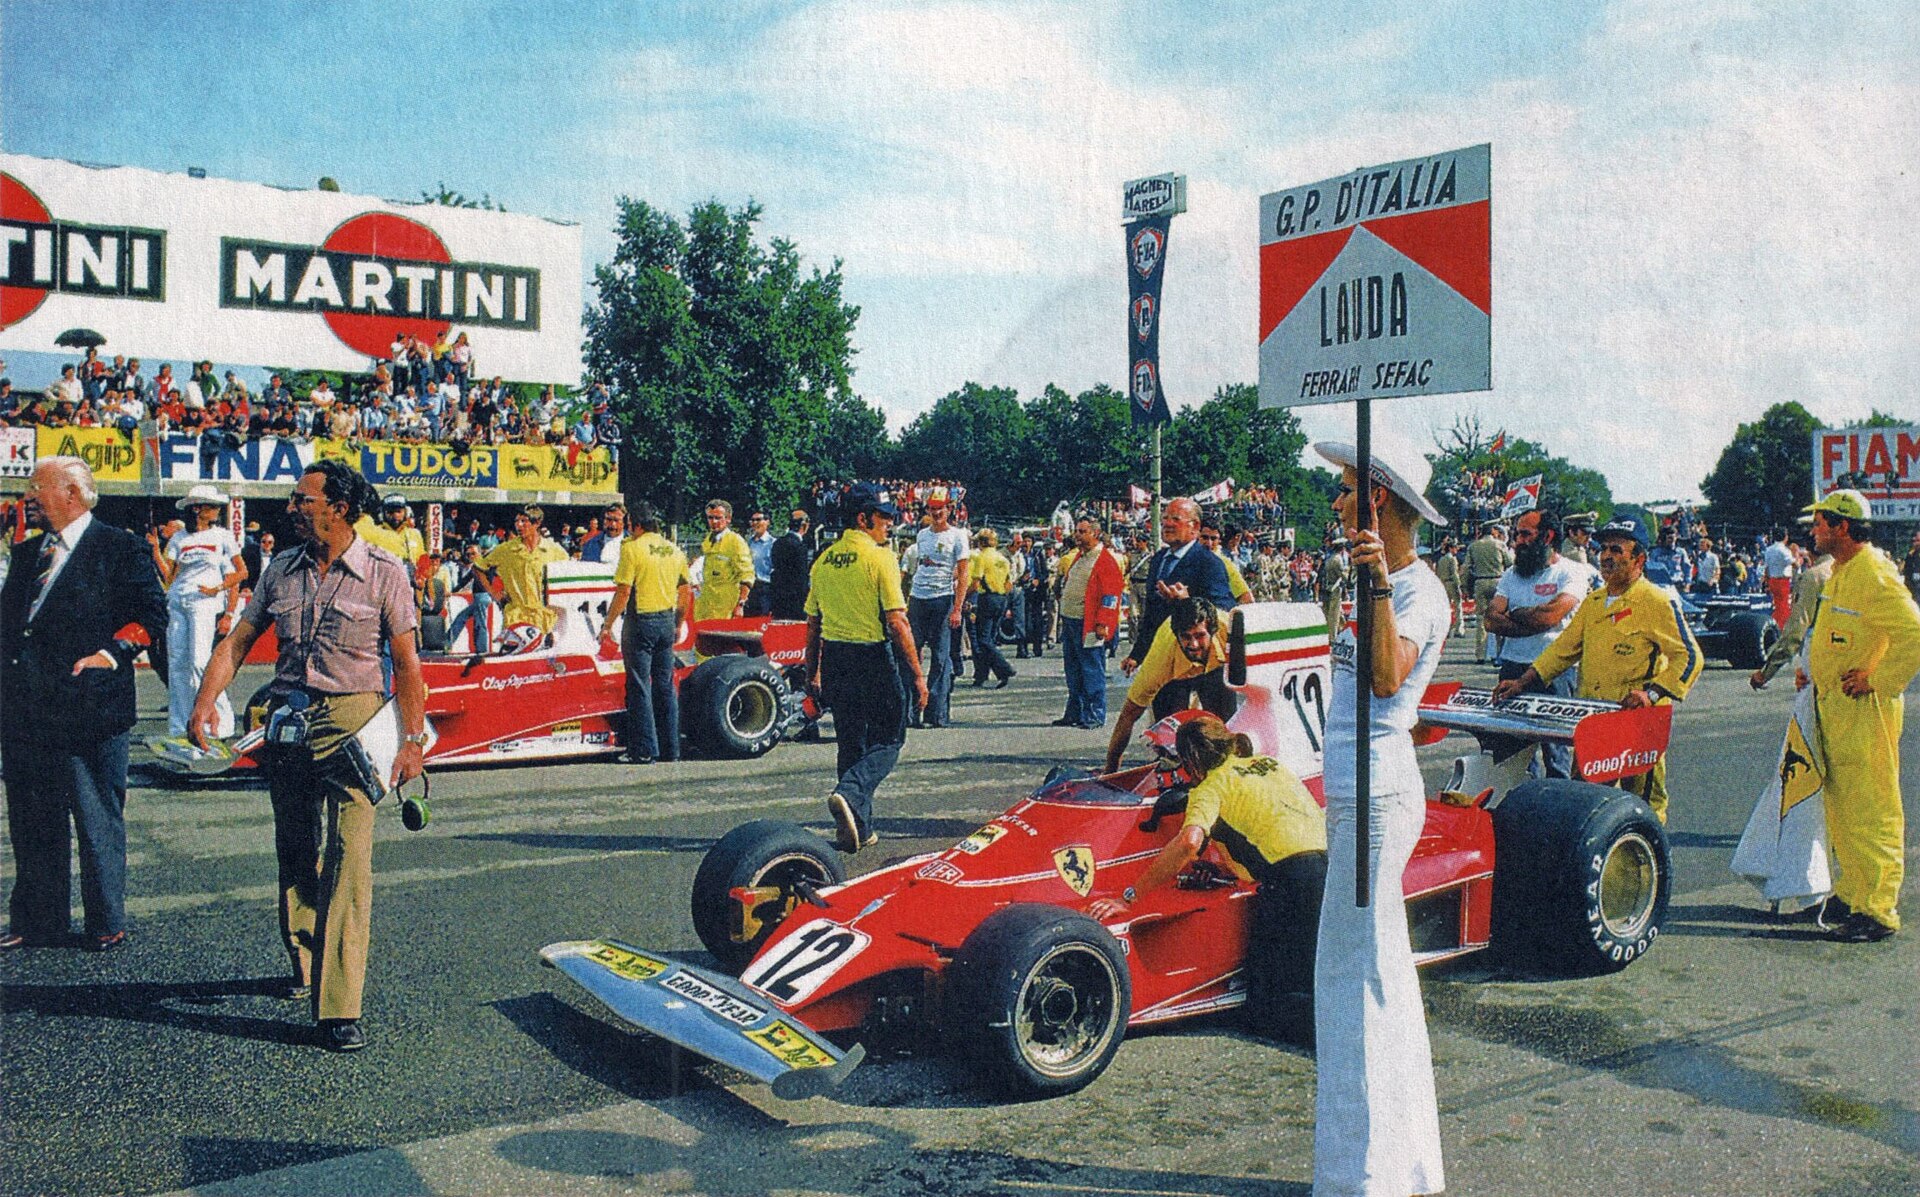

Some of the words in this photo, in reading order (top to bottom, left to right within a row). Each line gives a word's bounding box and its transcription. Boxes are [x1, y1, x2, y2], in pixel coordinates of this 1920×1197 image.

[1276, 189, 1321, 237] G.P.
[1334, 158, 1456, 225] D'ITALIA
[235, 249, 527, 322] MARTINI
[1320, 272, 1408, 347] LAUDA
[1300, 365, 1362, 398] FERRARI
[1371, 358, 1434, 390] SEFAC
[57, 434, 136, 473] Agip
[160, 434, 304, 481] FINA
[369, 446, 492, 477] TUDOR
[549, 450, 609, 485] Agip
[822, 549, 858, 568] Agip
[752, 925, 856, 1002] 12
